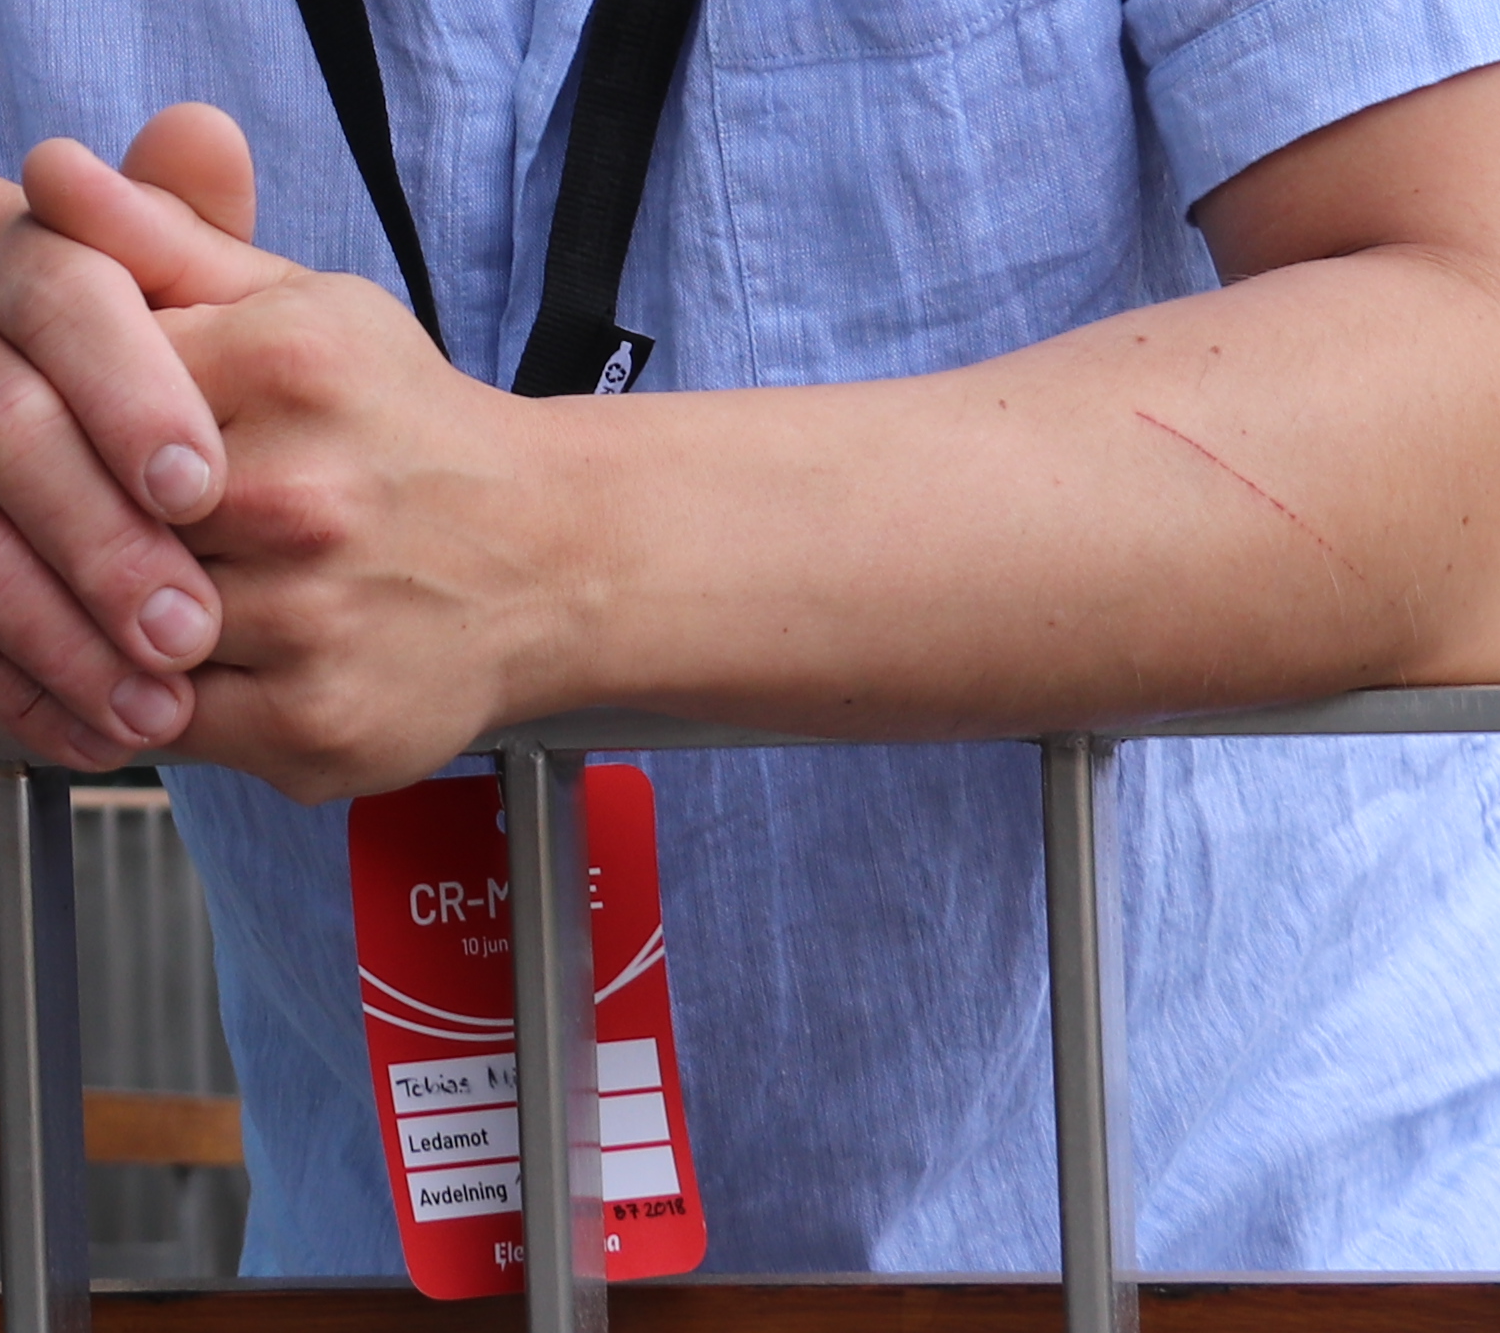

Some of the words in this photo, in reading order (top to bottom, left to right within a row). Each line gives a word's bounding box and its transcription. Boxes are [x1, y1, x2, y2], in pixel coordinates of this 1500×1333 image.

[409, 866, 604, 926] CR-ME
[462, 938, 480, 956] 10
[408, 1128, 490, 1154] Ledamot
[419, 1181, 509, 1208] Avdelning
[643, 1197, 687, 1218] 2018
